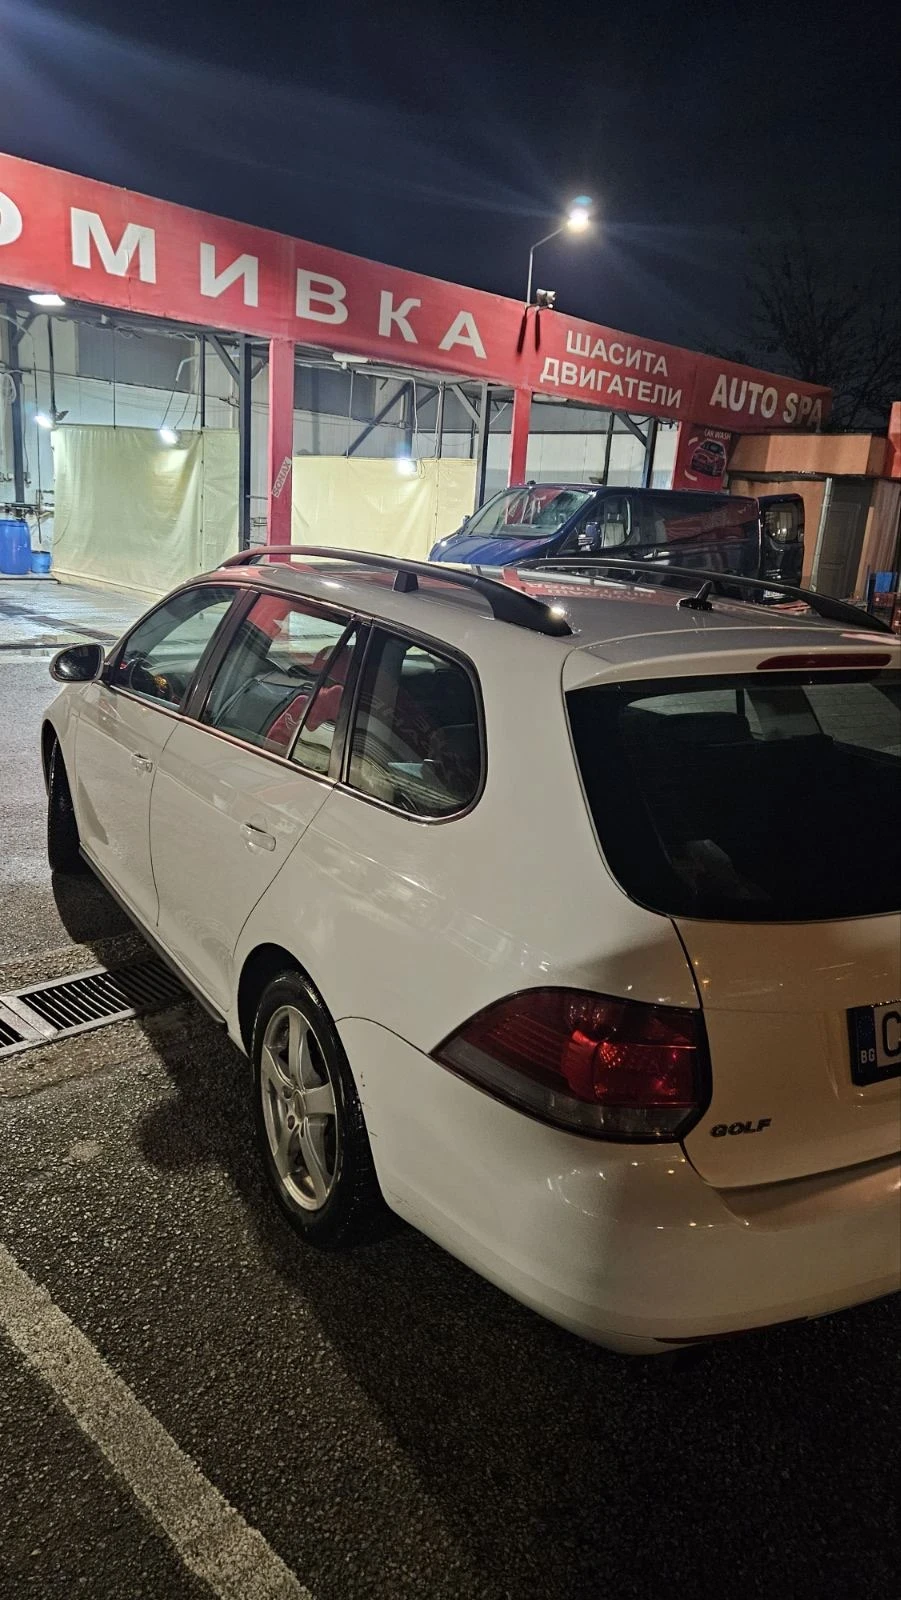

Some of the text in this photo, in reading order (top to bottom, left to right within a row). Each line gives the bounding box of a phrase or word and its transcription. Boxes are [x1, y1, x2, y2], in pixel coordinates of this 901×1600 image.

[566, 330, 669, 377] ШАСИТА
[539, 356, 682, 409] ДВИГАТЕЛИ
[709, 374, 822, 432] AUTO SPA
[861, 1047, 875, 1064] BG
[710, 1118, 772, 1138] GOLF
